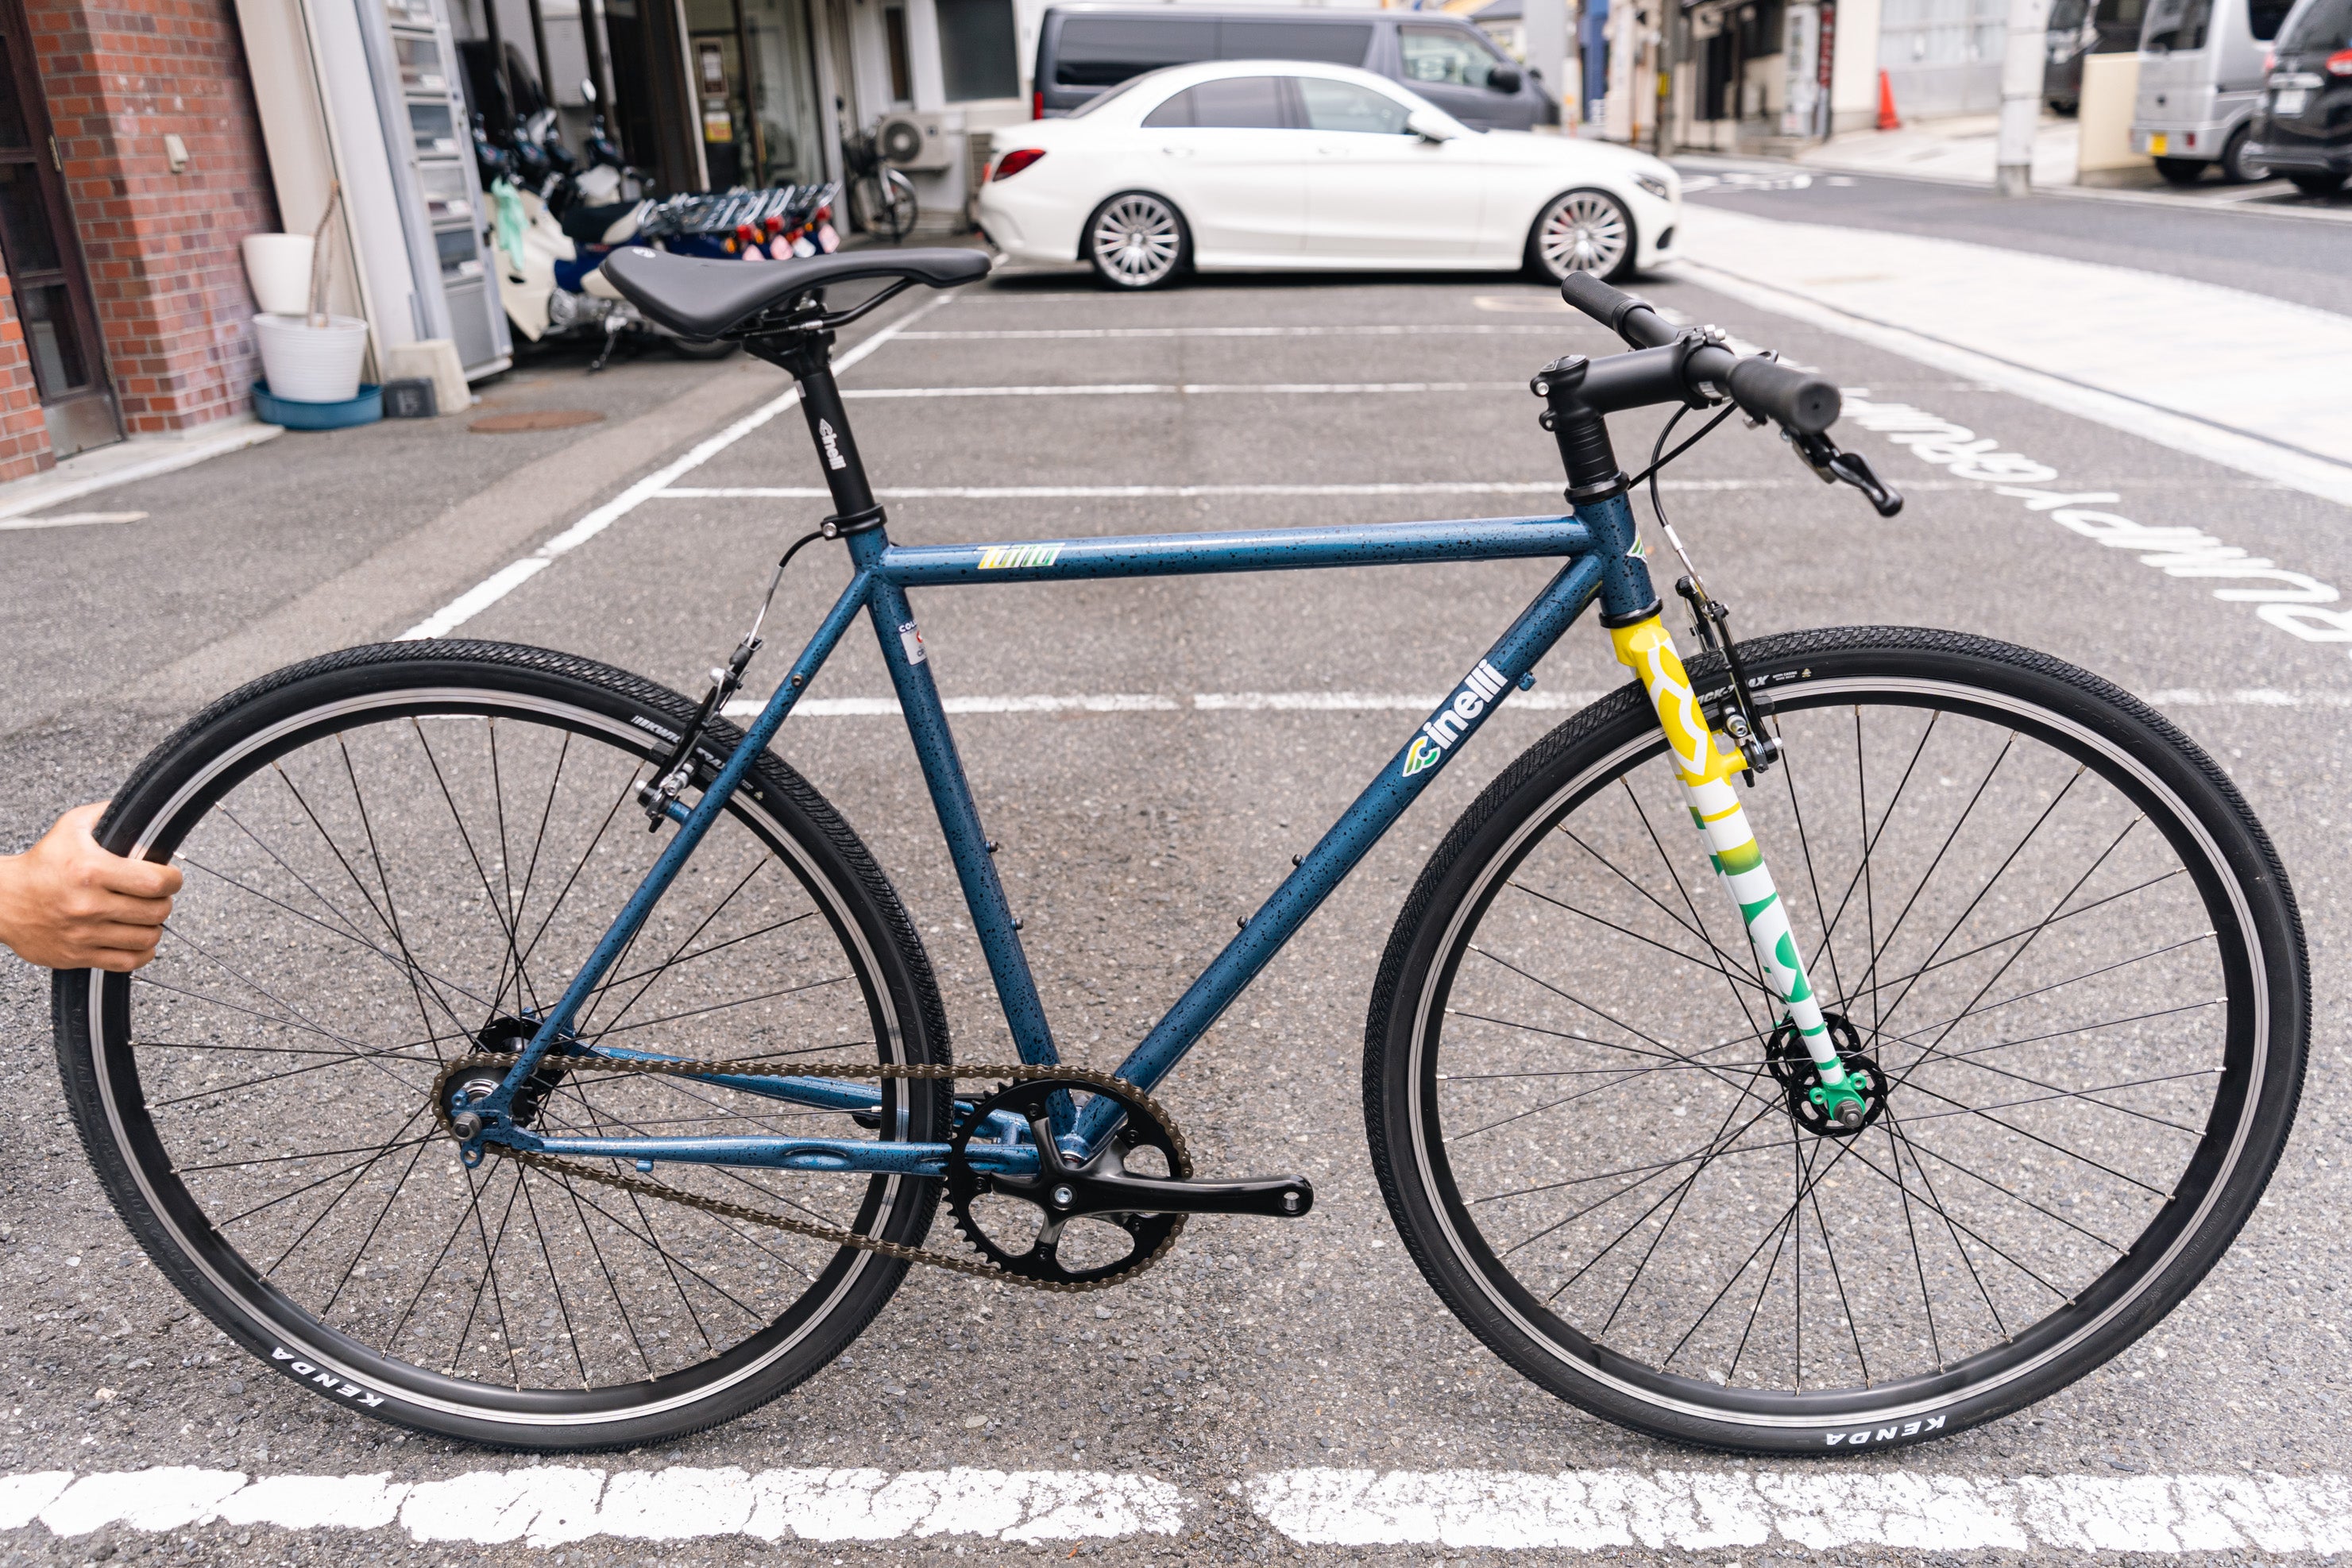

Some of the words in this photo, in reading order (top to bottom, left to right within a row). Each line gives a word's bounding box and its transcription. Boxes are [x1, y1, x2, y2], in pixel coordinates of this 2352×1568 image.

[1994, 485, 2352, 642] RUMPY
[272, 1346, 385, 1408] KENDA
[1826, 1415, 1946, 1446] KENDA
